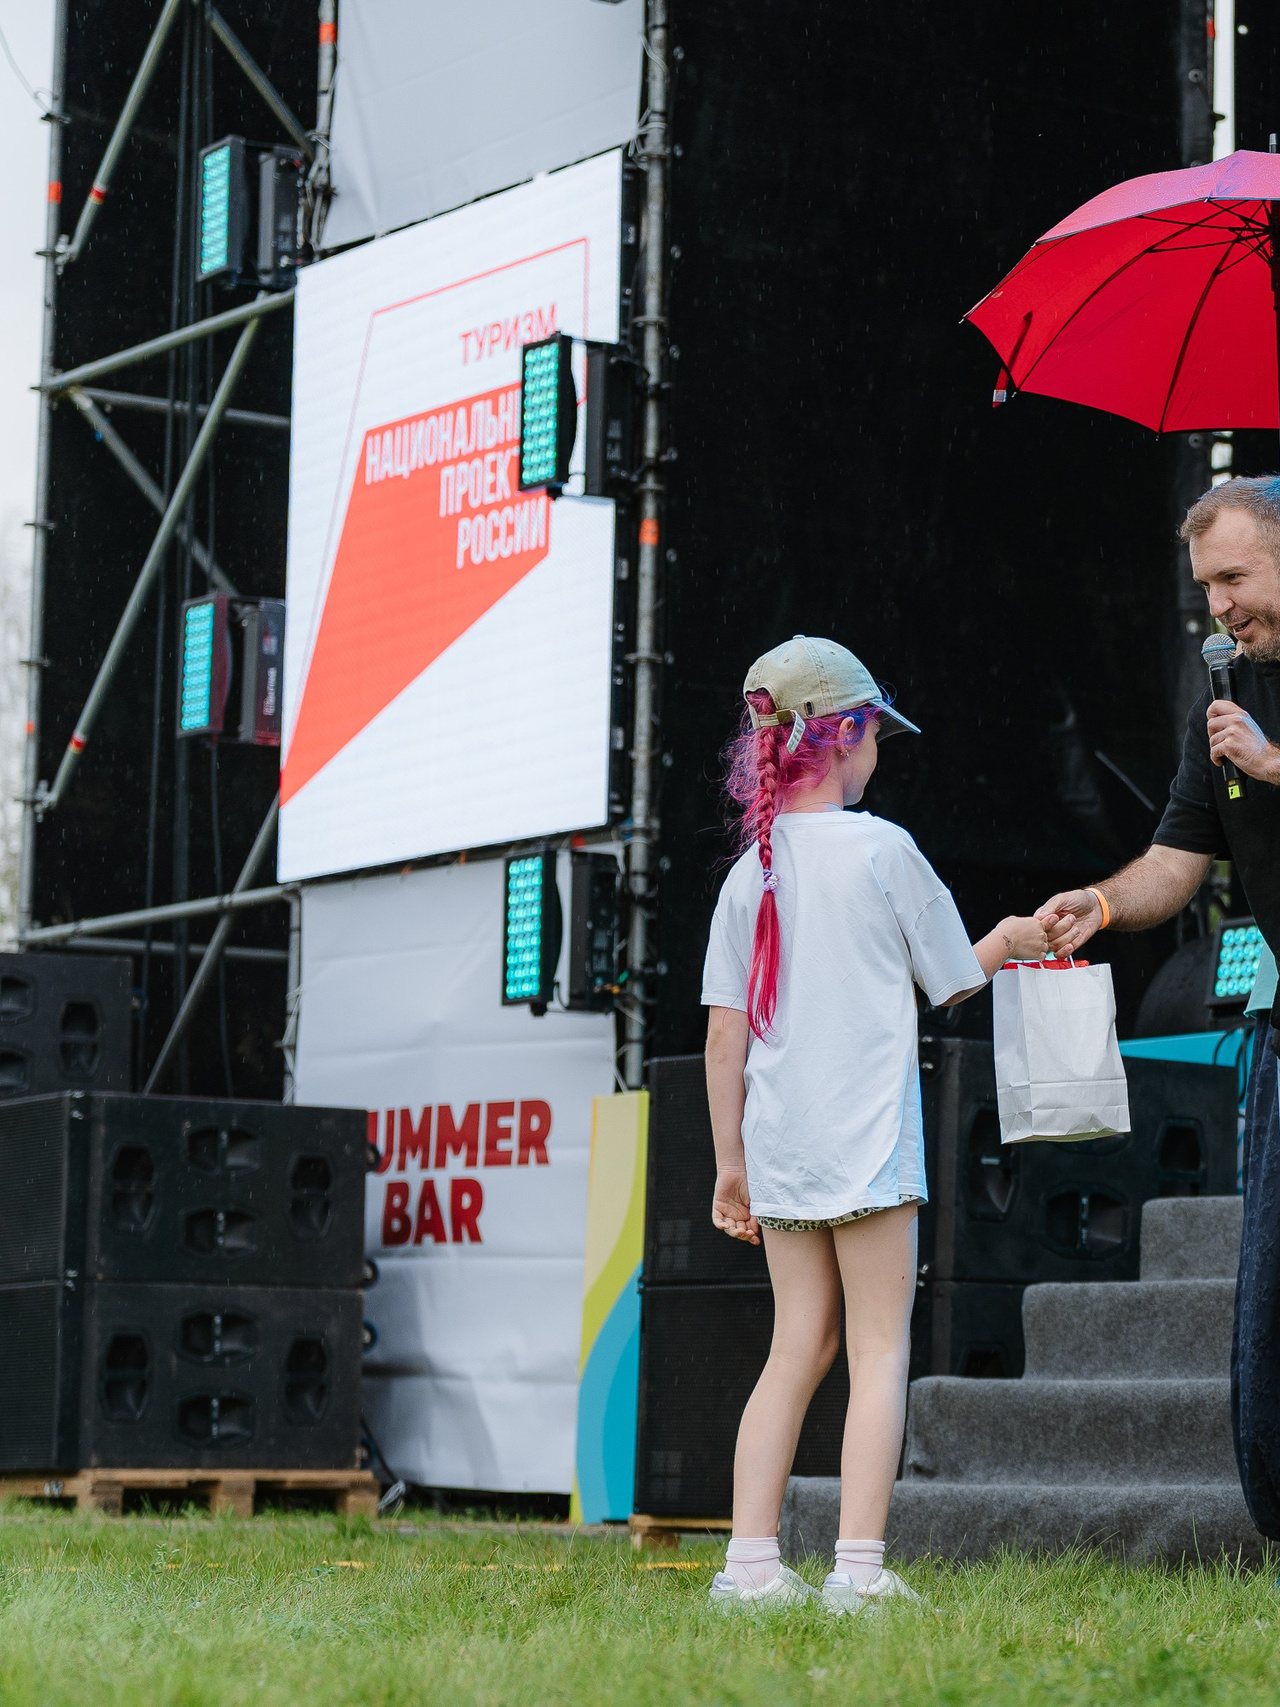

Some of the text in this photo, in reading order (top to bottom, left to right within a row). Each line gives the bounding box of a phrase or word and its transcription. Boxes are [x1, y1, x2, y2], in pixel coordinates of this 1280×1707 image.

[459, 303, 557, 366] ТУРИЗМ
[365, 388, 522, 485] НАЦИОНАЛЬН
[439, 446, 520, 518] ПРОЕК
[456, 495, 548, 570] РОССИИ
[366, 1099, 552, 1175] UMMER
[381, 1177, 483, 1245] BAR
